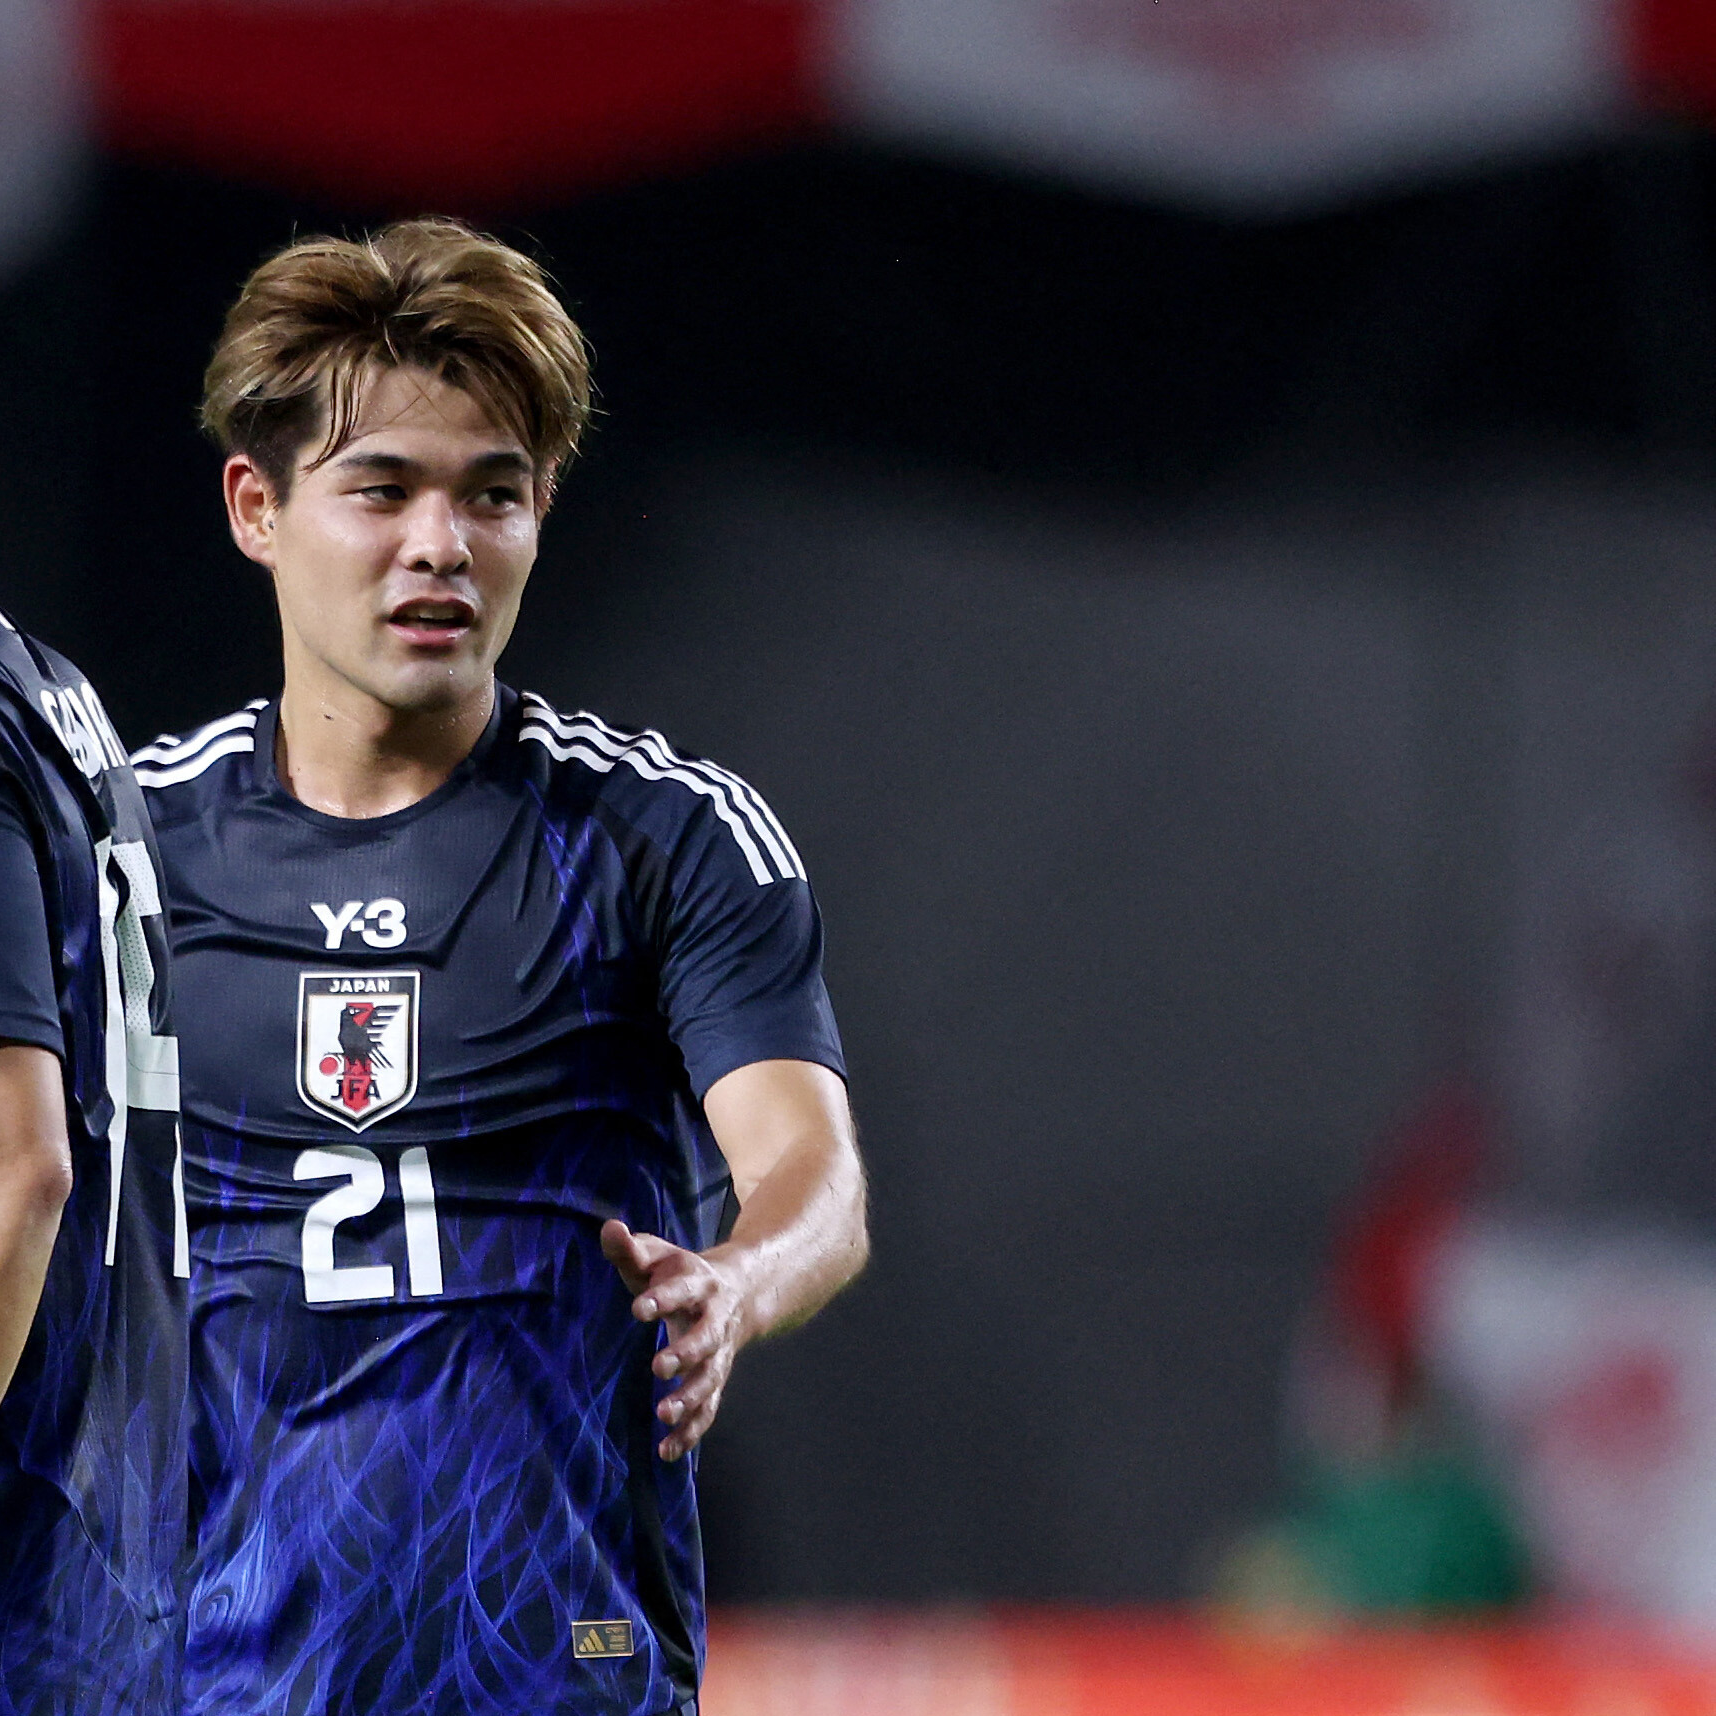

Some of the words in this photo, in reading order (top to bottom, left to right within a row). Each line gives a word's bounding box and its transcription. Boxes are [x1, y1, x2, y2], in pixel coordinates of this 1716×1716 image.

[310, 898, 407, 950] Y-3
[329, 979, 391, 993] JAPAN
[330, 1079, 382, 1101] JFA
[293, 1145, 444, 1303] 21
